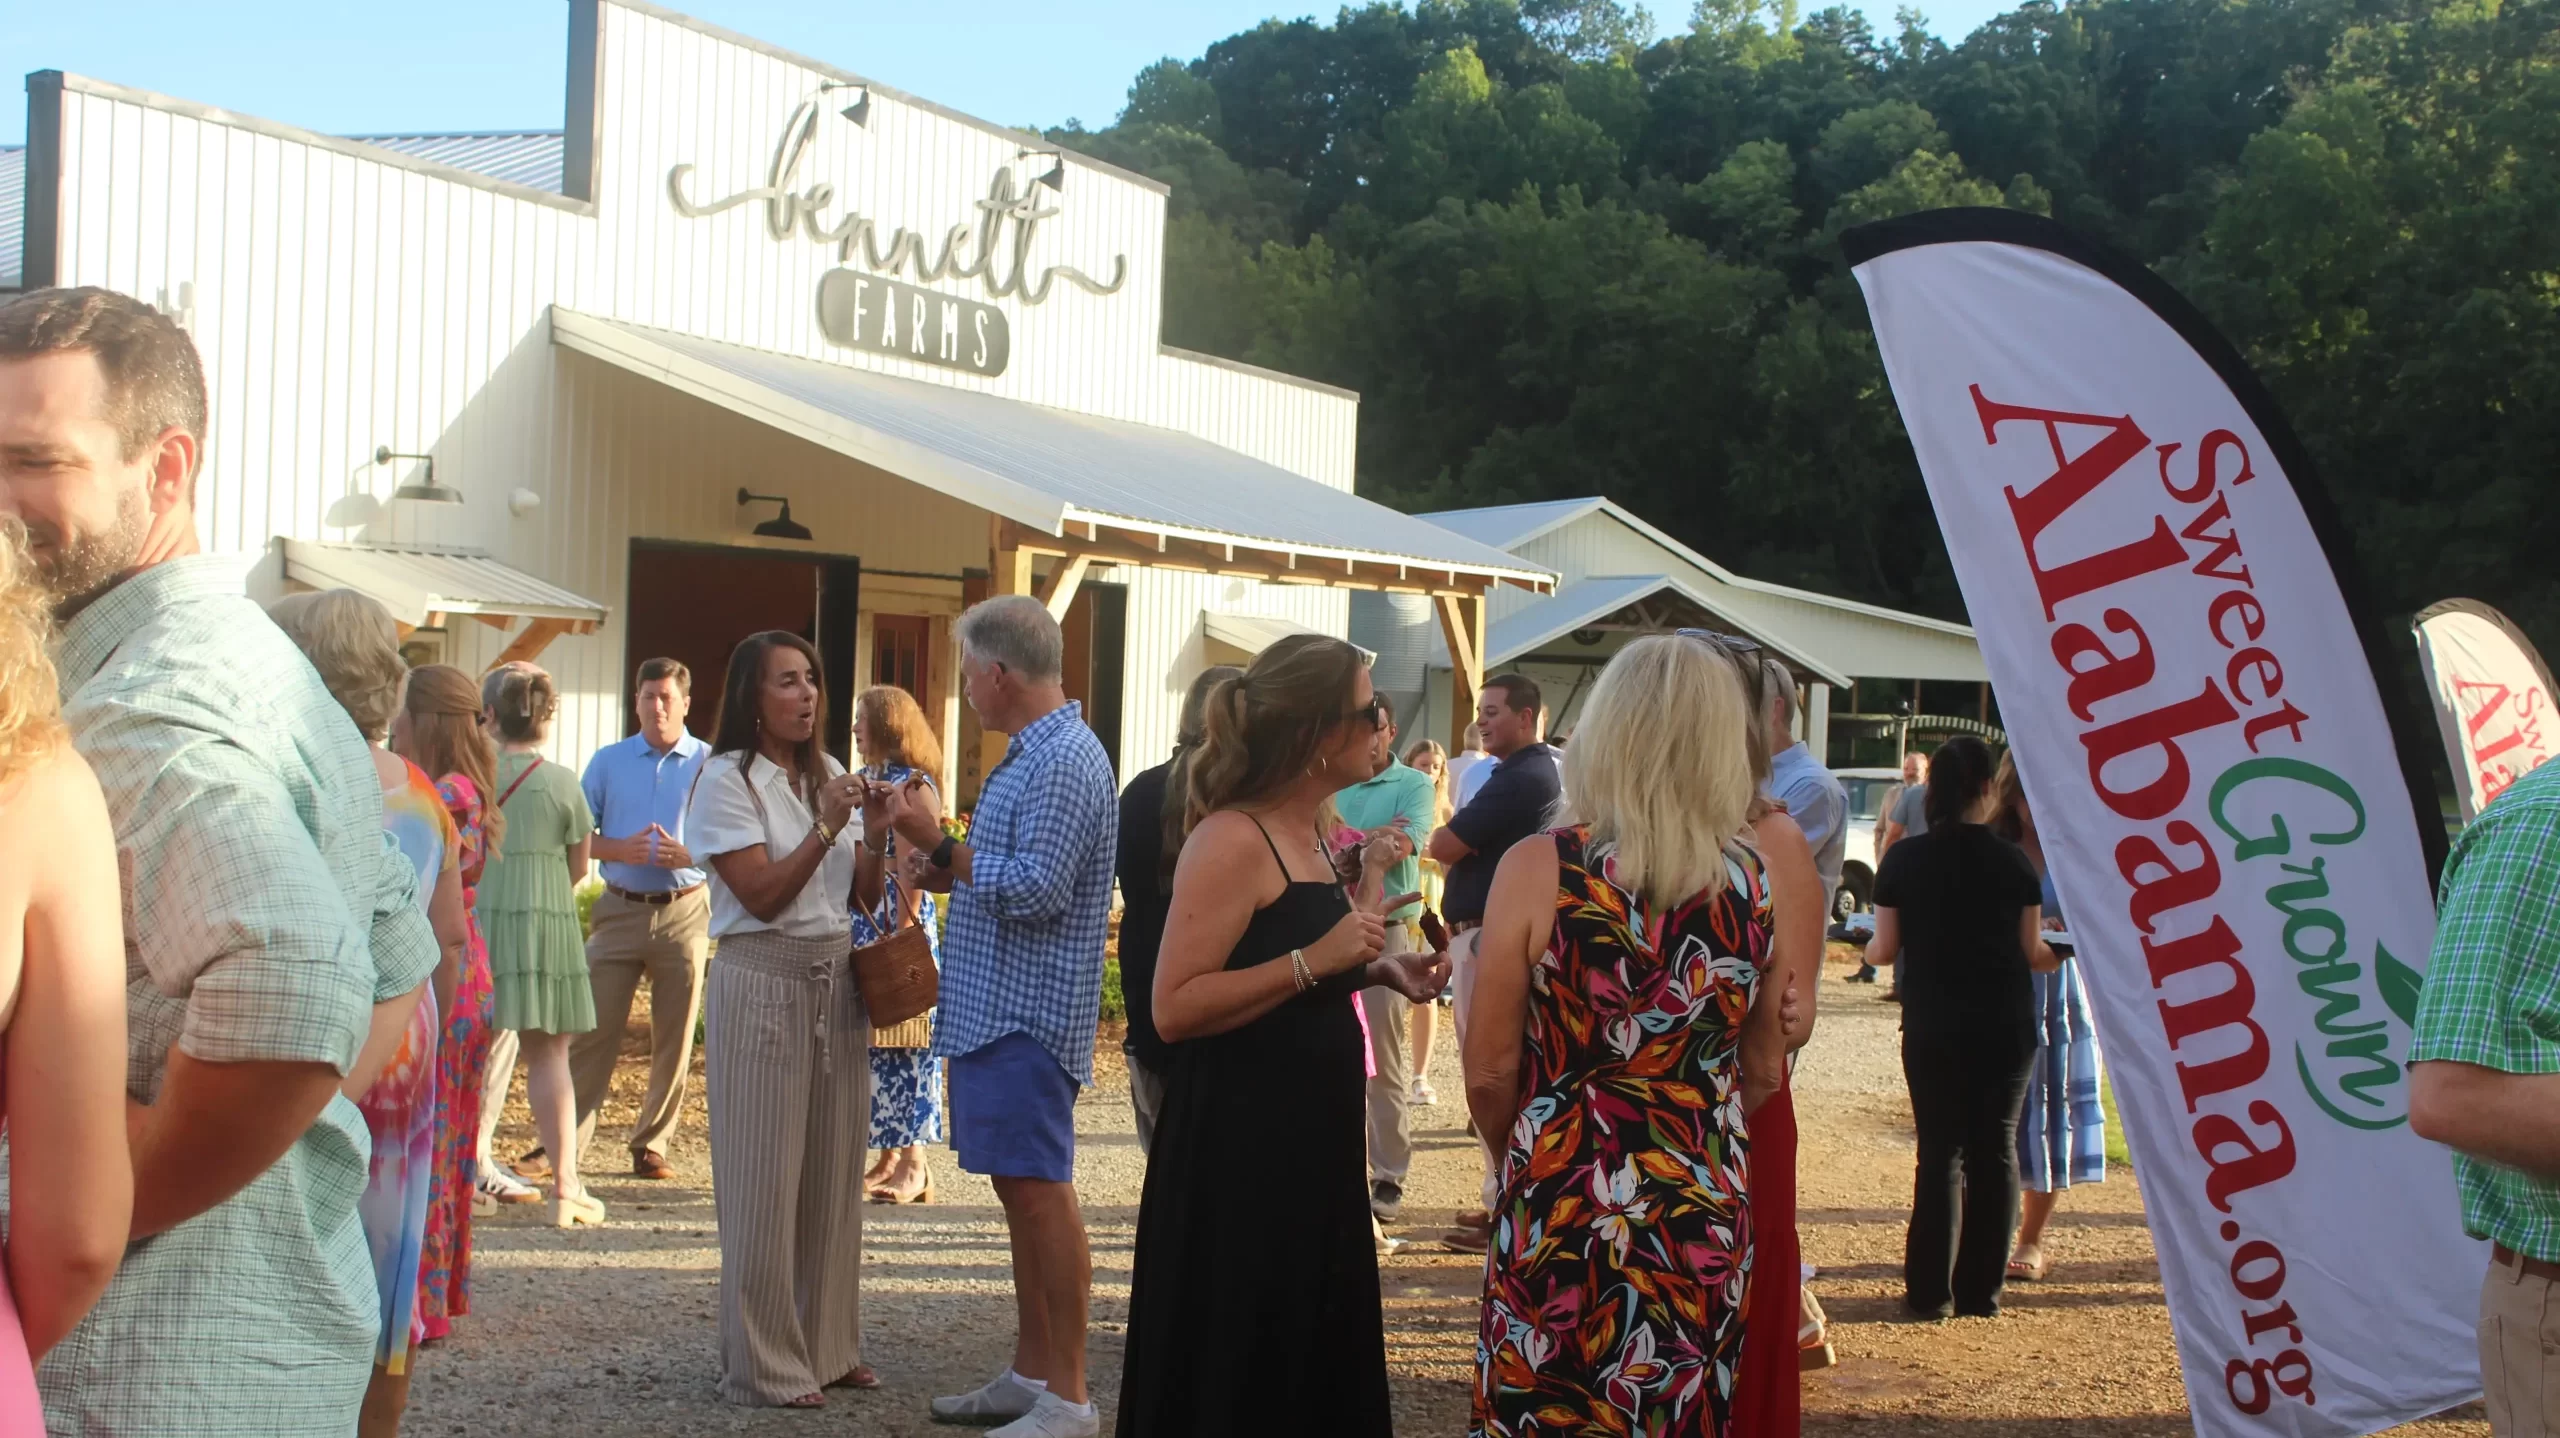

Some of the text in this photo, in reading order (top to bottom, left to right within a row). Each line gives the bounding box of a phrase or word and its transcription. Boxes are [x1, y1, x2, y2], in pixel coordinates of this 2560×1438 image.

[668, 101, 1126, 305] bennett
[853, 279, 989, 368] FARMS
[1969, 384, 2315, 1416] Alabama.org
[2156, 429, 2401, 1107] Sweet Grown
